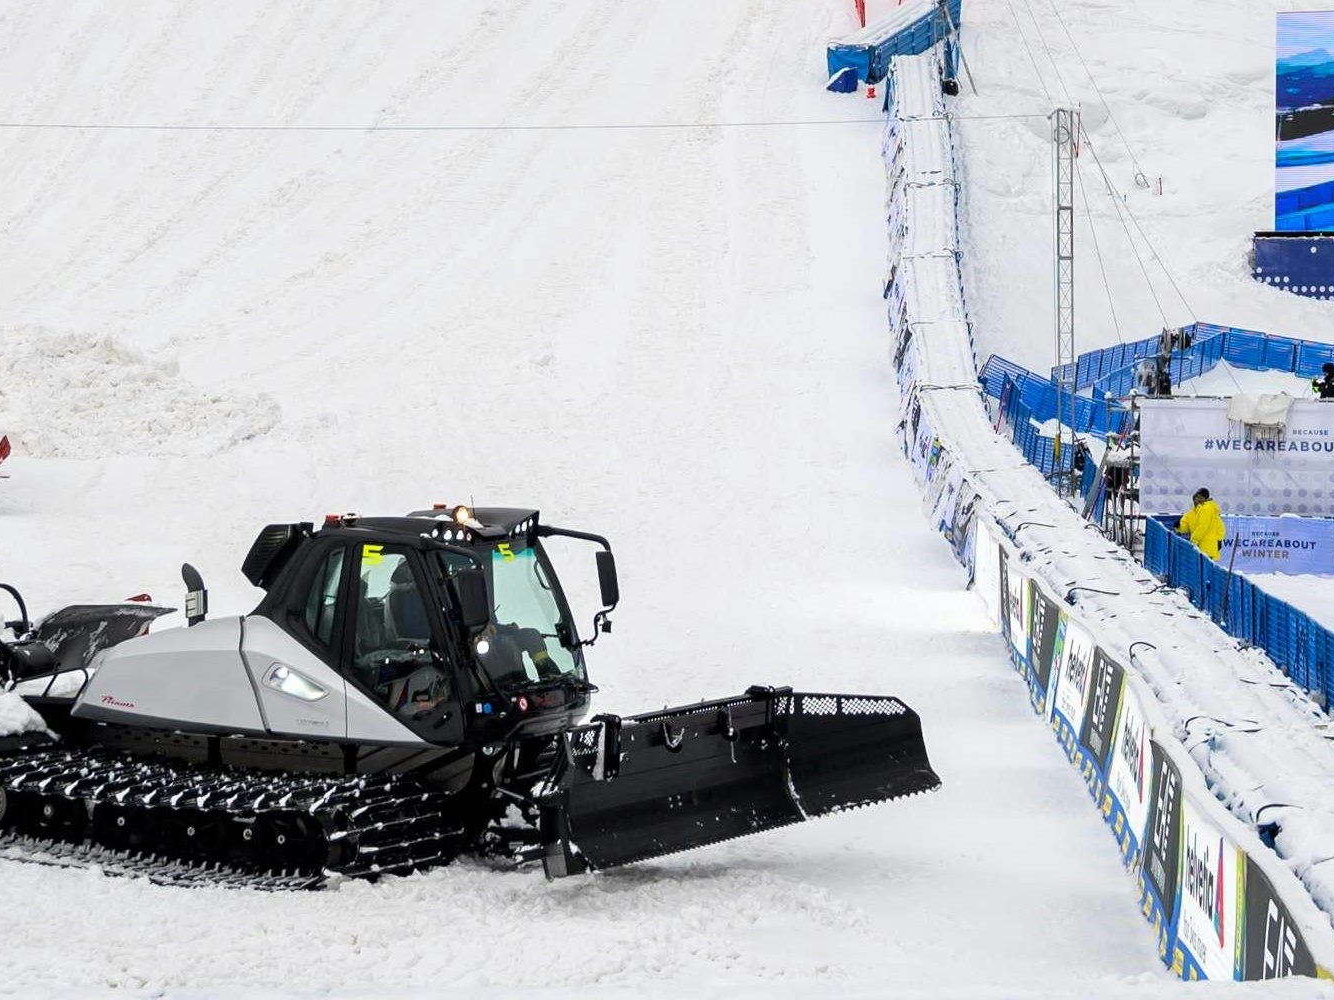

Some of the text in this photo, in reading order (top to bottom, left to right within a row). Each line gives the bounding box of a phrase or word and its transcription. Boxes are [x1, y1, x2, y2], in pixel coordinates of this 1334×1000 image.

[362, 544, 385, 566] 5
[497, 543, 516, 562] 5
[1241, 549, 1289, 559] WINTER
[1185, 824, 1214, 923] helvetia
